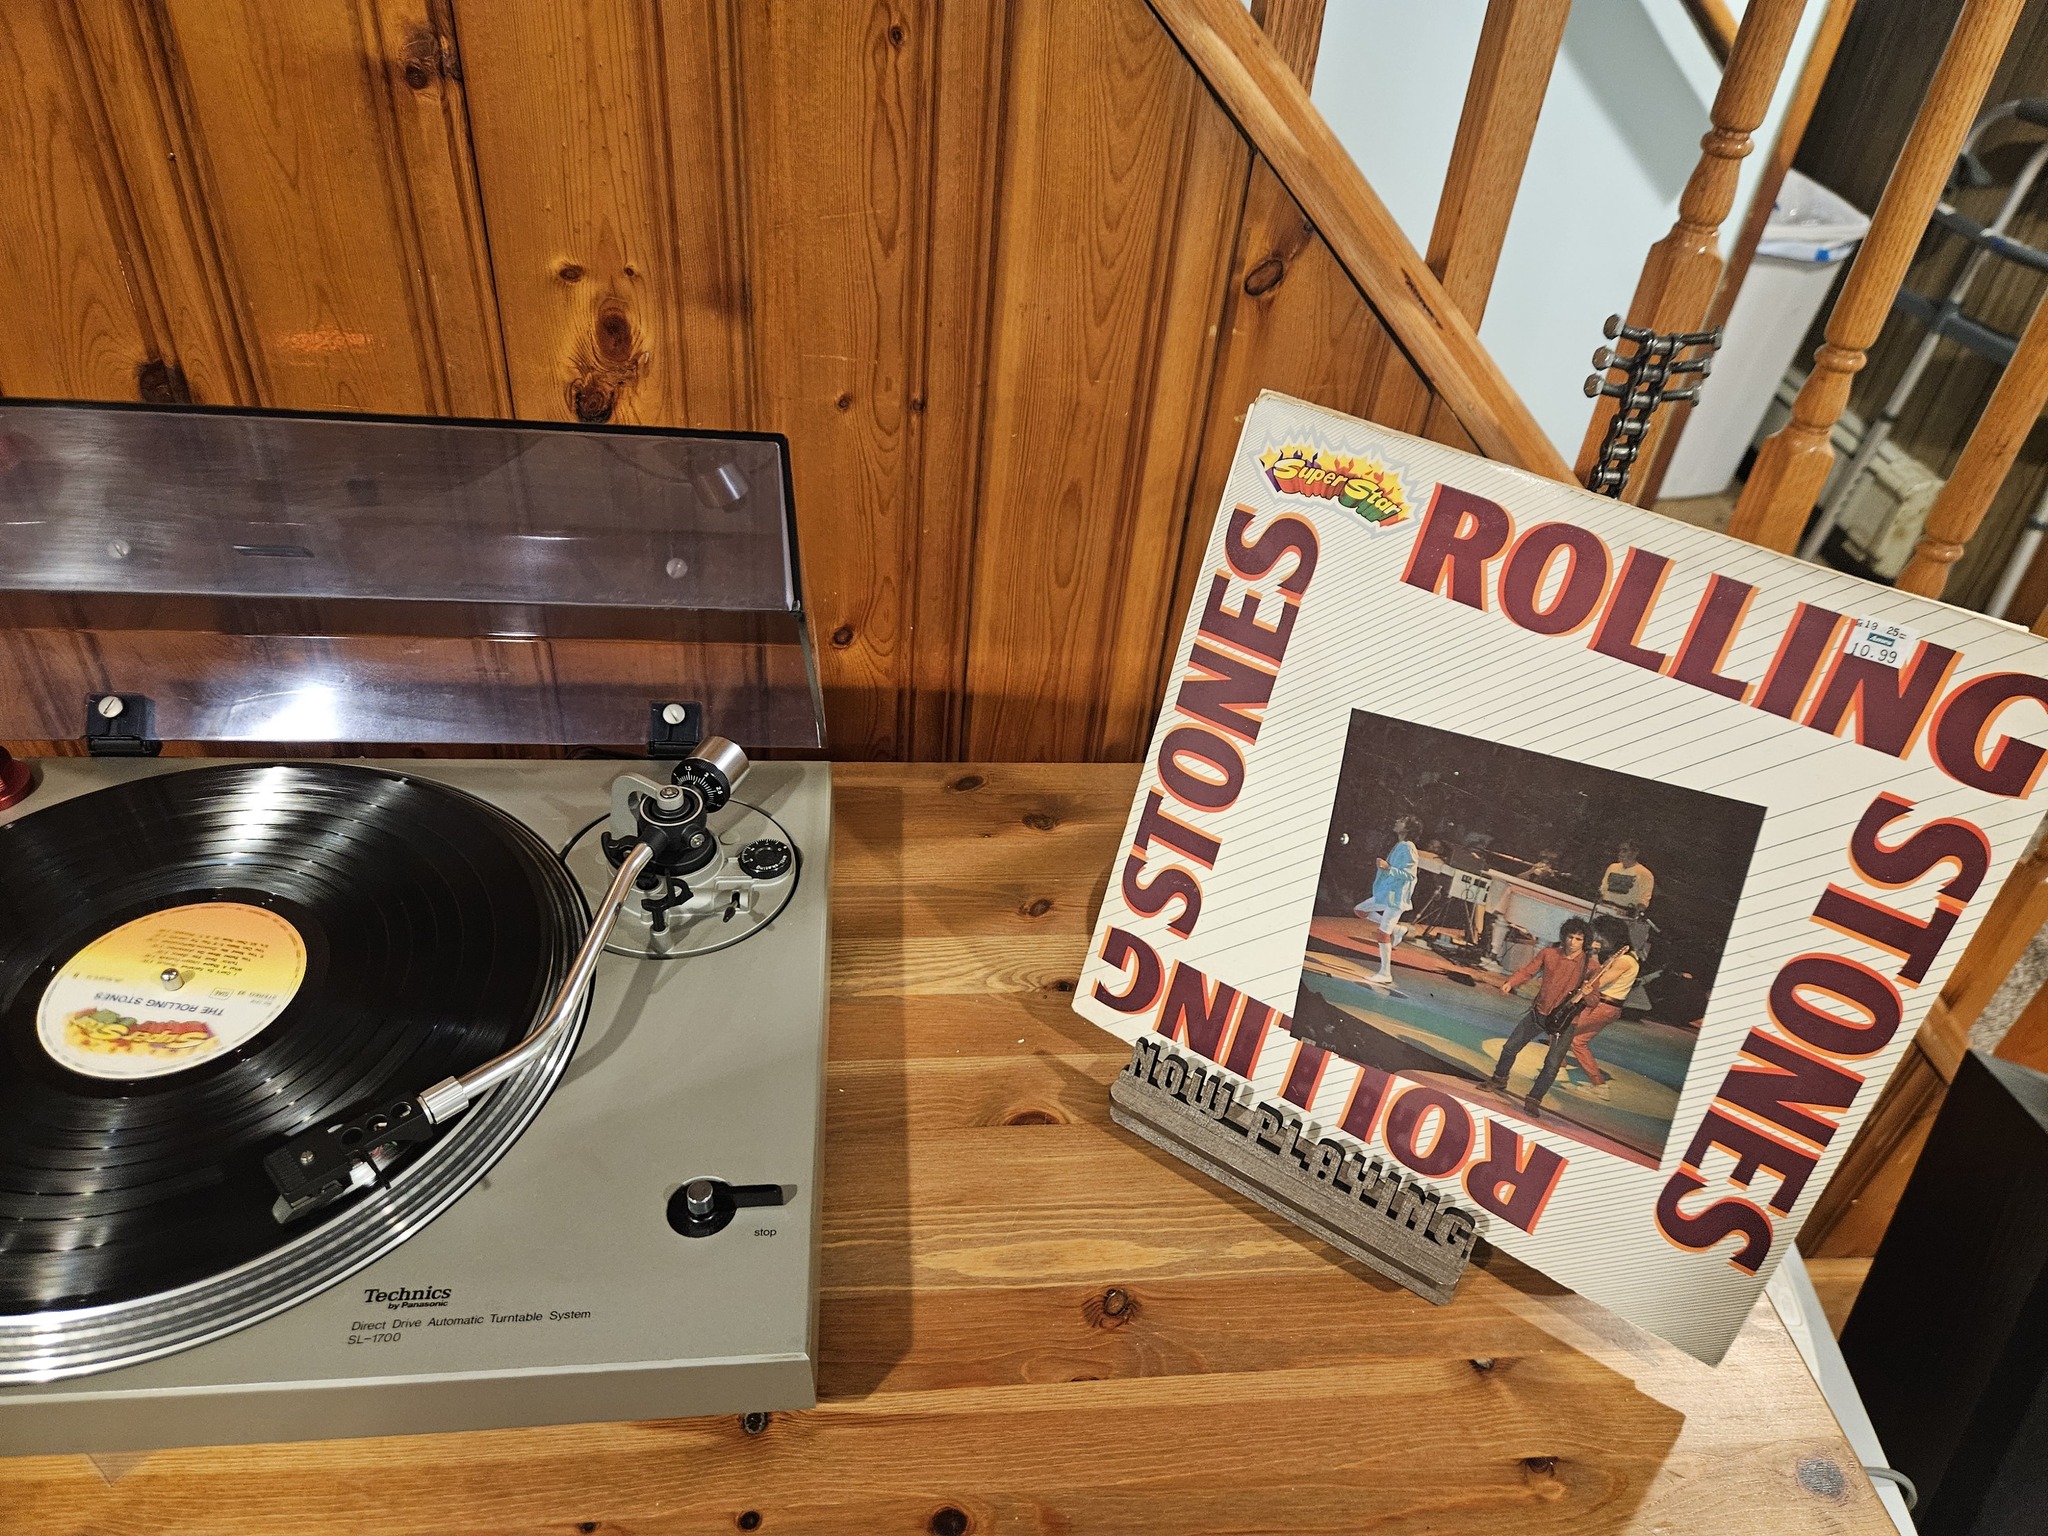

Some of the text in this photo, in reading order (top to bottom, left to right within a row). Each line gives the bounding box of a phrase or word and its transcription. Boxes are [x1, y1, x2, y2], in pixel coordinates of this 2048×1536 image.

[1400, 482, 2048, 800] ROLLING
[1850, 642, 1898, 664] 10.99
[1120, 503, 1320, 941] STONES
[93, 992, 225, 1016] THE ROLLING STONES
[1655, 790, 1992, 1276] STONES
[1246, 1101, 1476, 1250] PLAYING
[753, 1228, 777, 1238] stop
[364, 1285, 452, 1303] Technics
[387, 1300, 449, 1310] by Panasonic
[351, 1310, 592, 1331] Direct Drive Automatic Turntable System
[347, 1332, 402, 1345] SL-1700
